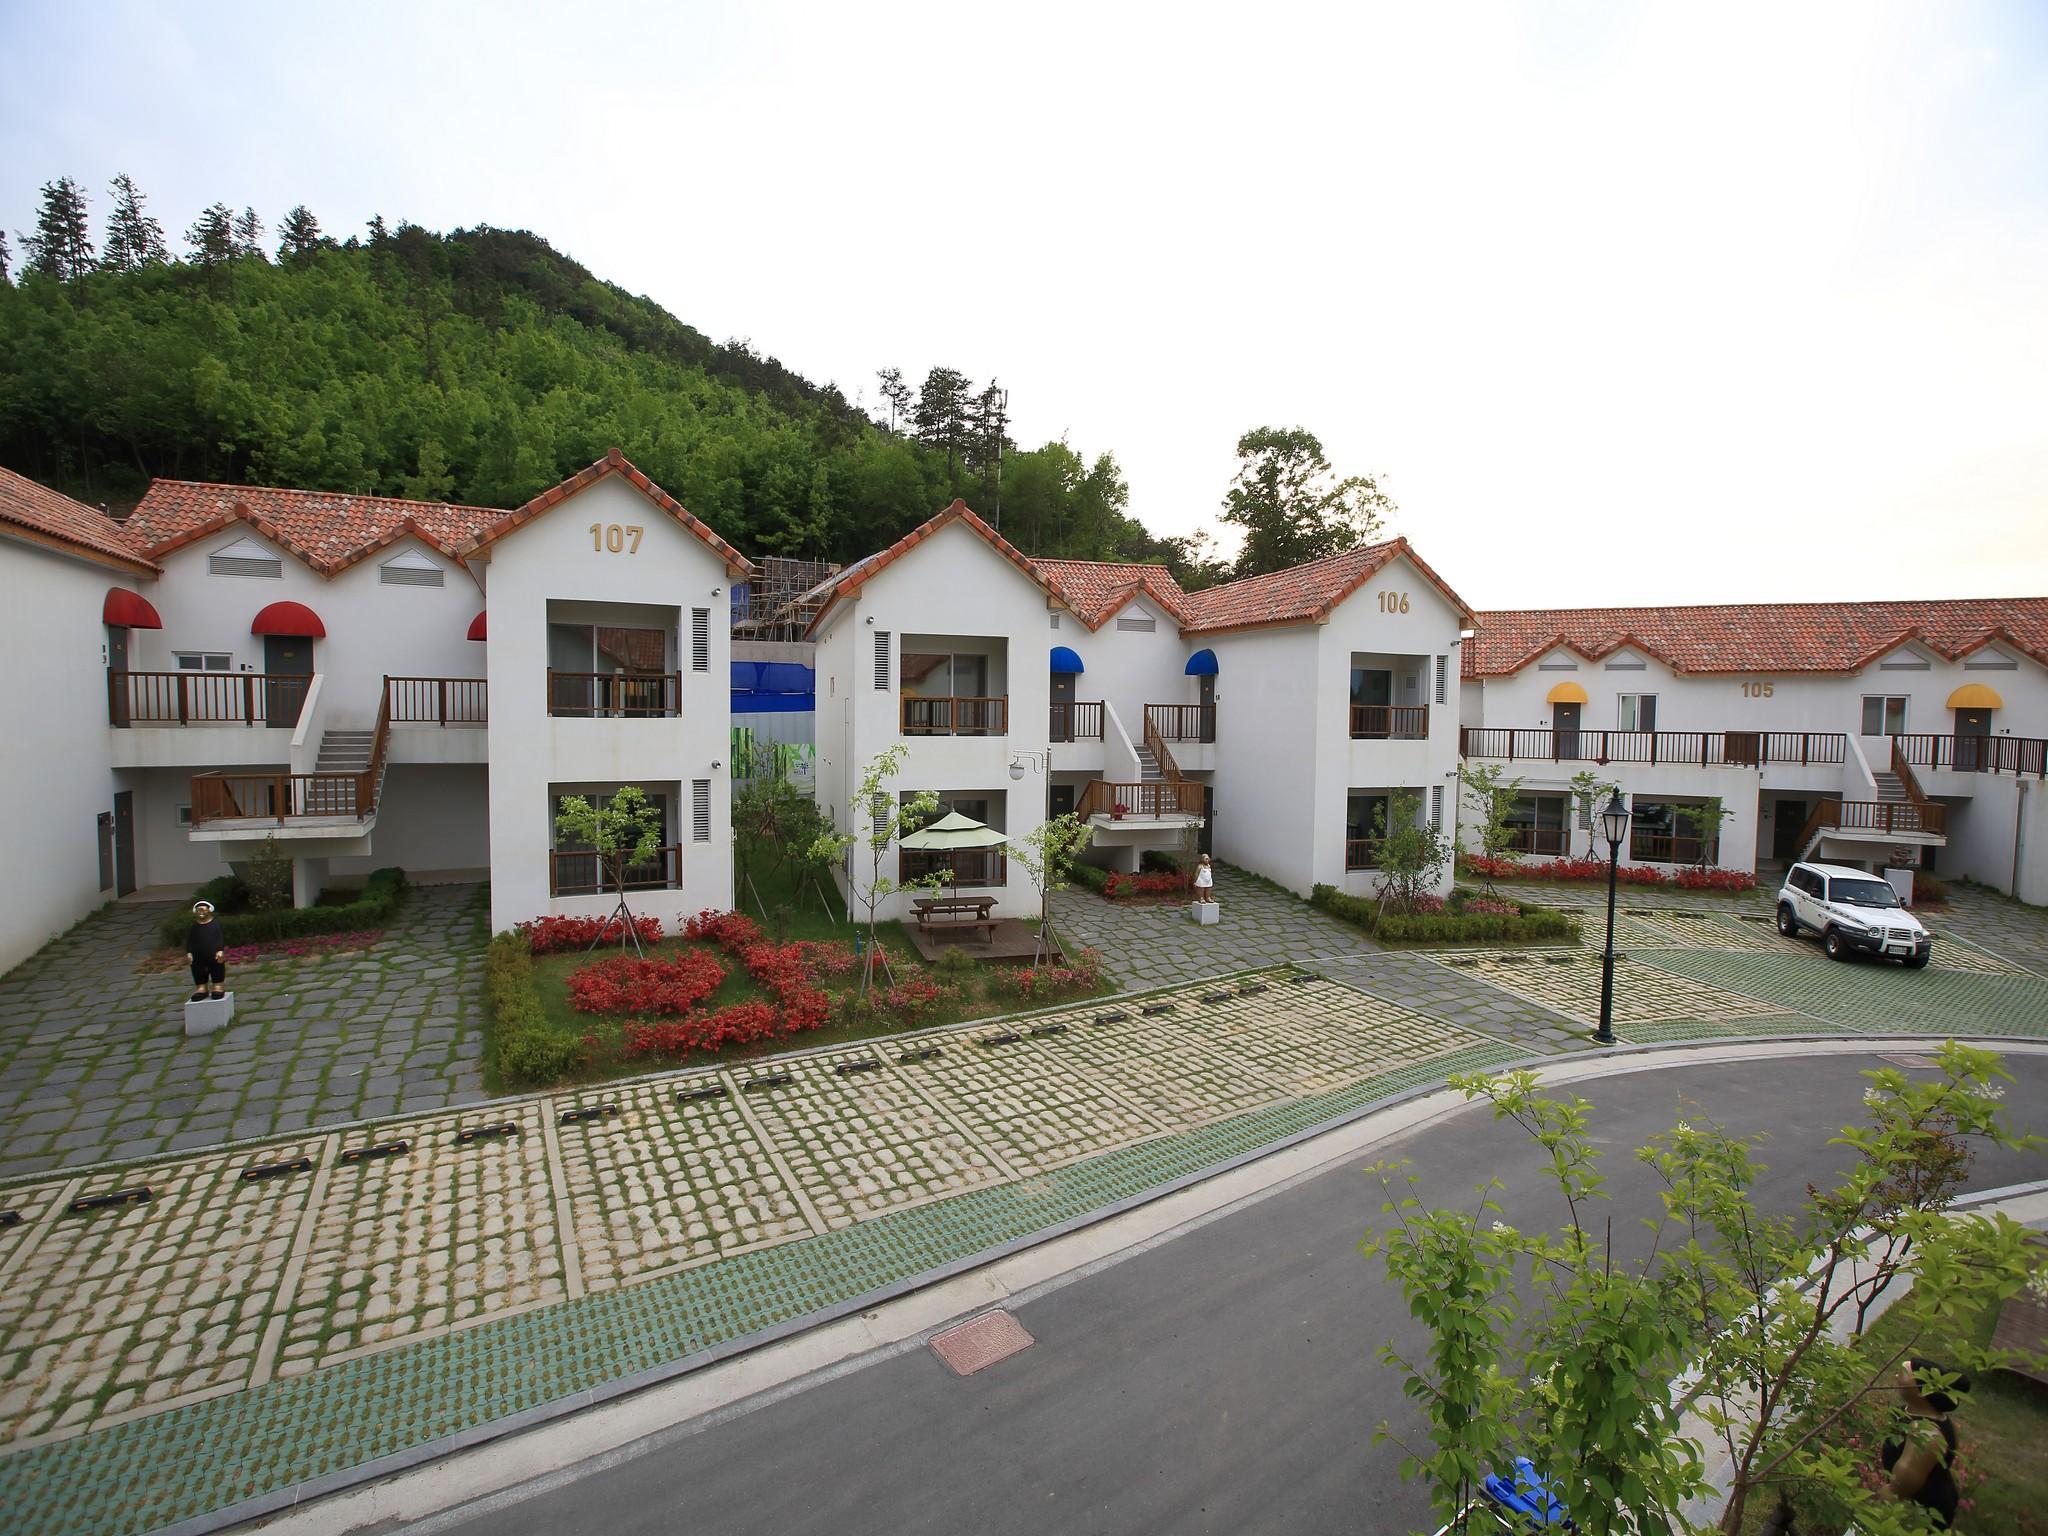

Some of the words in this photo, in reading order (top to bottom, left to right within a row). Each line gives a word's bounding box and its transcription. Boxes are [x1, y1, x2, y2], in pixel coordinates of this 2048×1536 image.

[590, 523, 644, 554] 107
[1378, 591, 1410, 614] 106
[1741, 681, 1774, 698] 105
